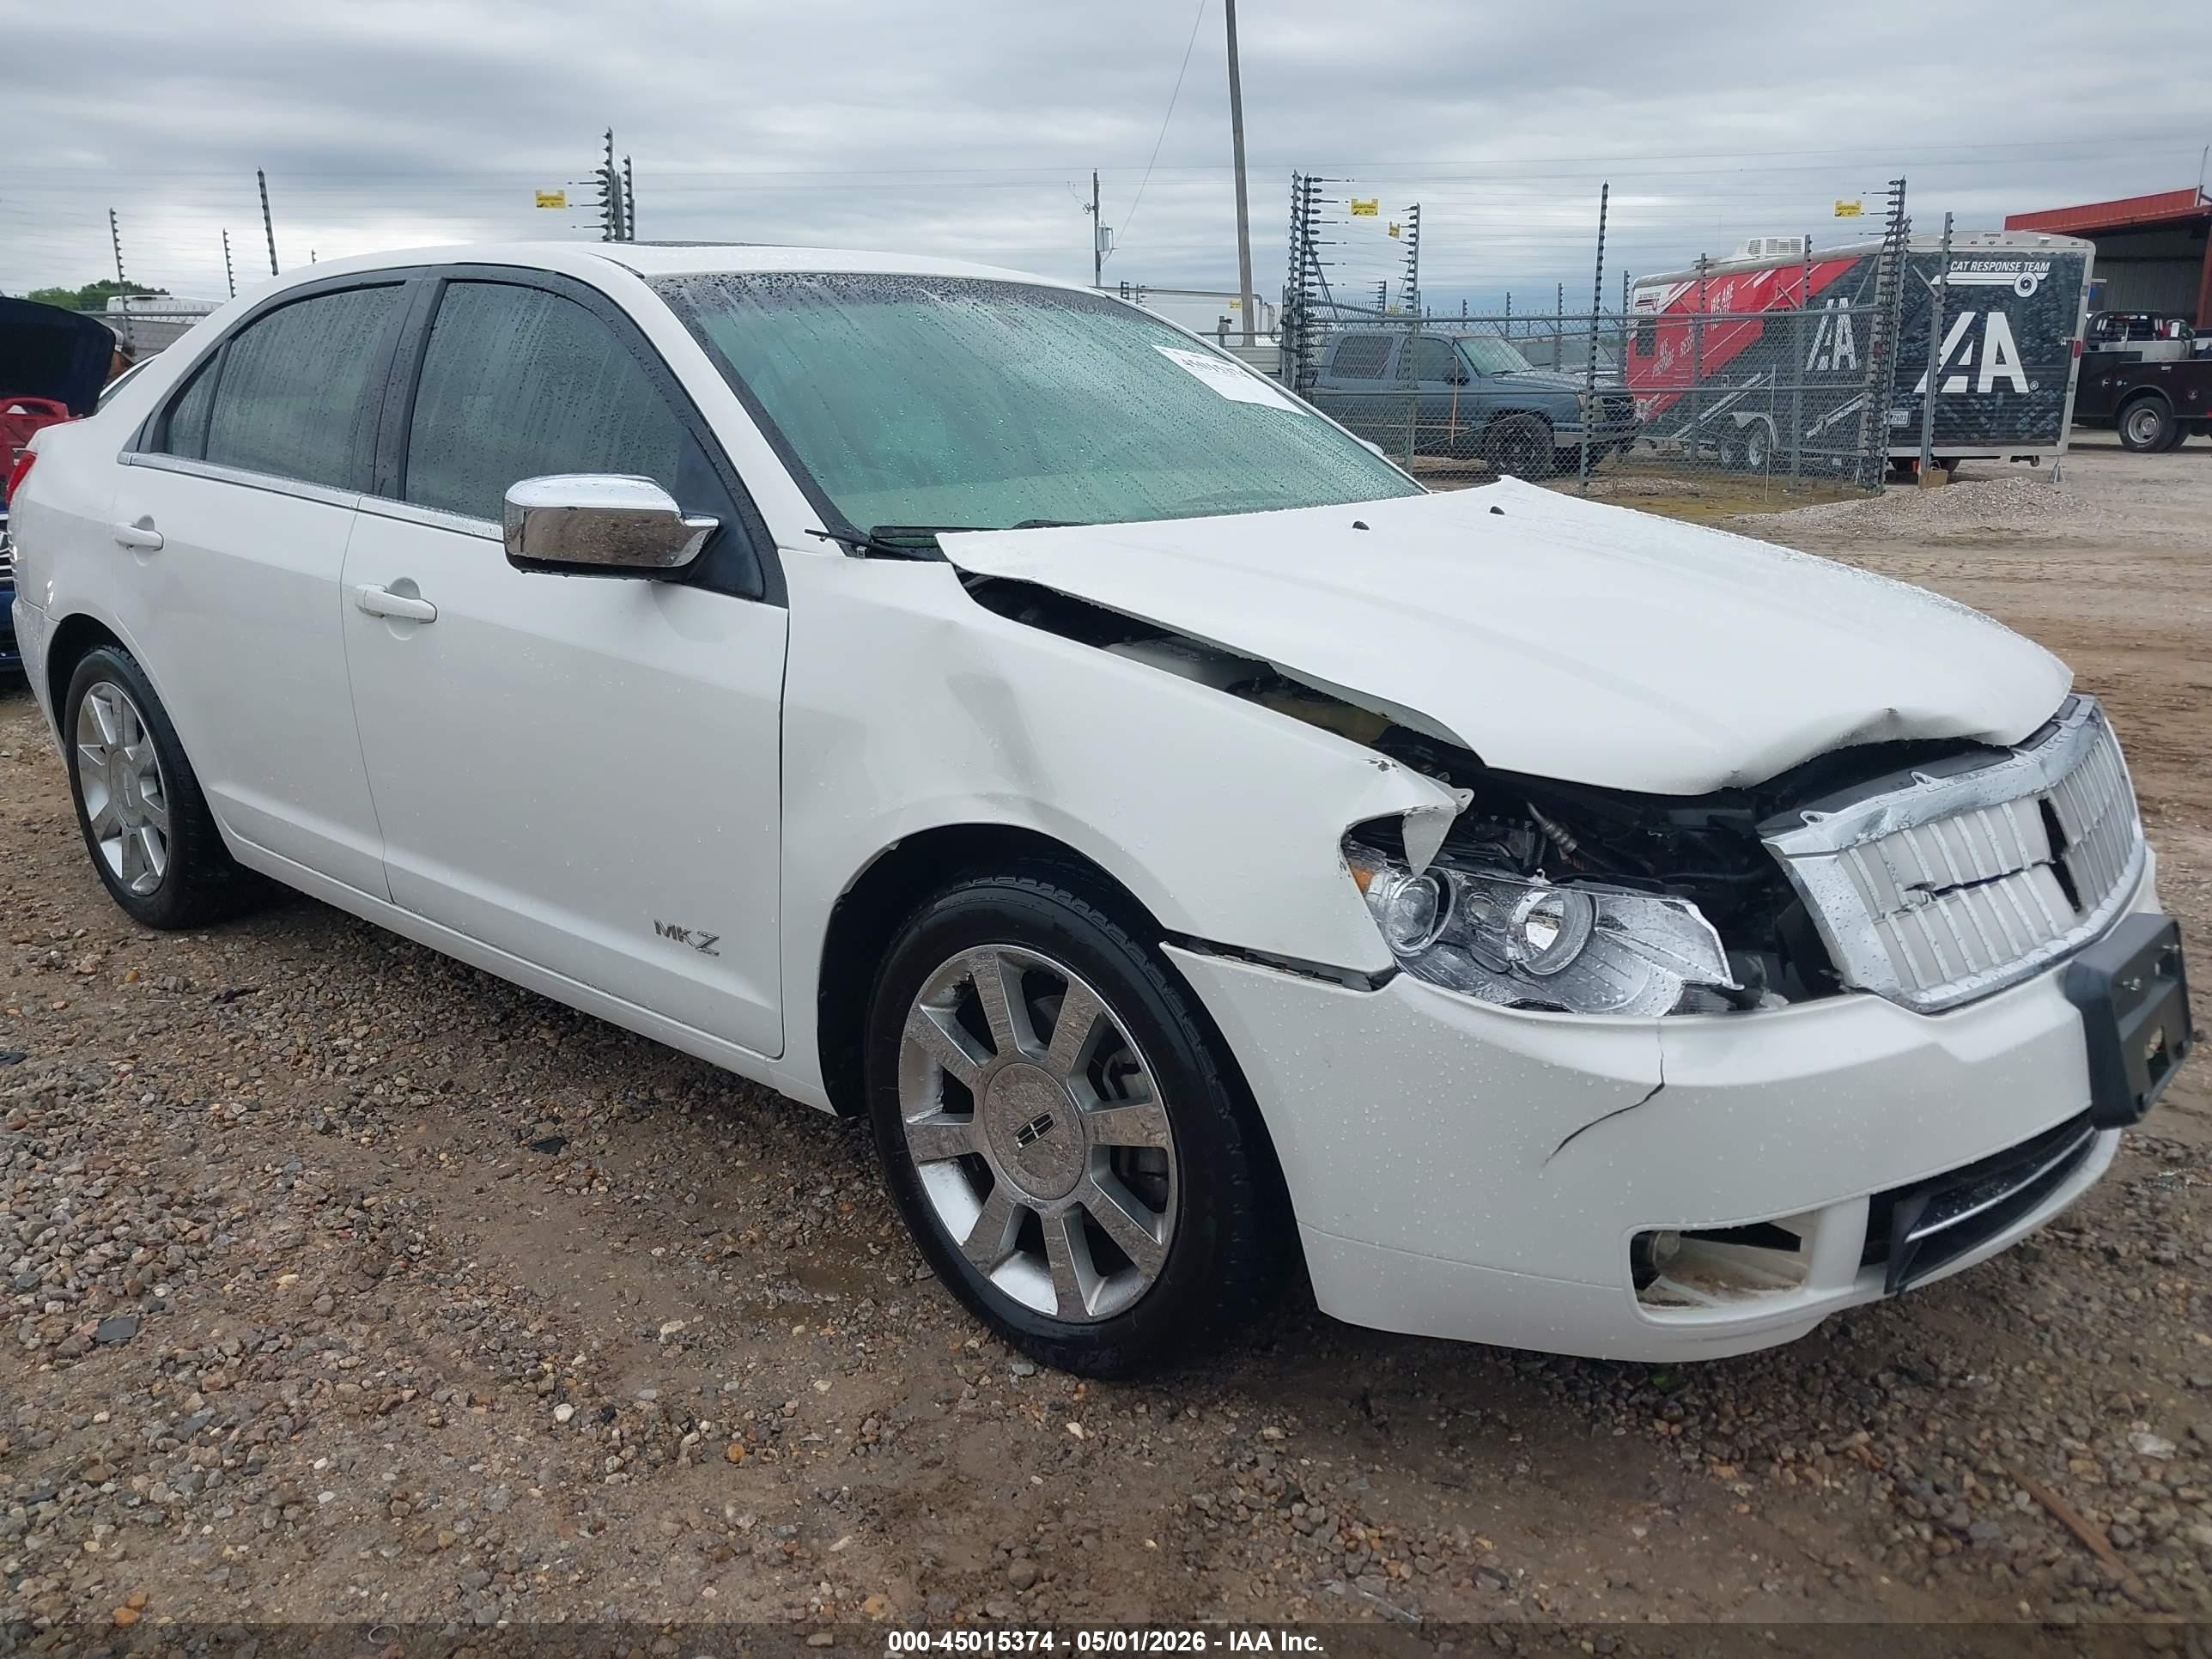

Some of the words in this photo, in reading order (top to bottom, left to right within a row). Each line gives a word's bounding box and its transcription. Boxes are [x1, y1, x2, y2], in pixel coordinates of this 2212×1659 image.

[1950, 261, 1971, 271] CAT
[1970, 261, 2022, 272] RESPONSE
[2023, 261, 2051, 272] TEAM
[653, 920, 720, 957] MKZ
